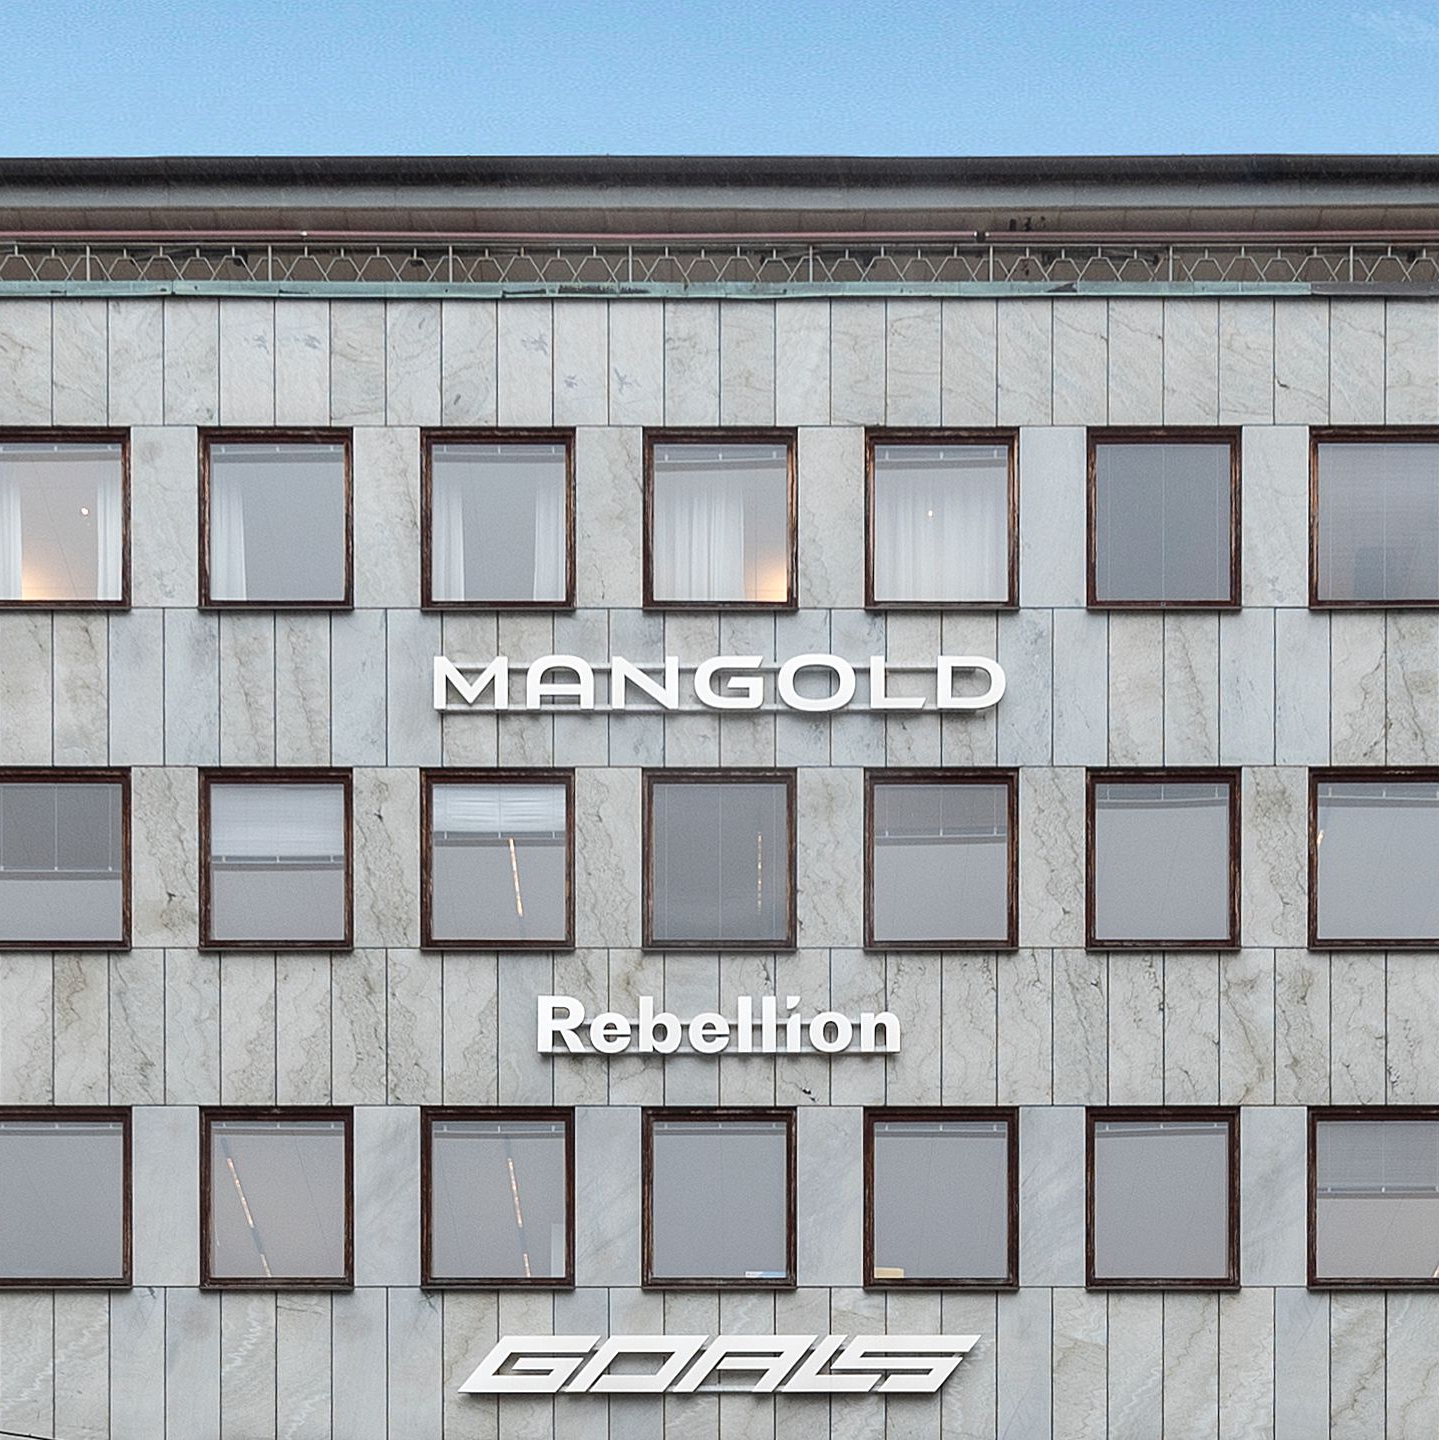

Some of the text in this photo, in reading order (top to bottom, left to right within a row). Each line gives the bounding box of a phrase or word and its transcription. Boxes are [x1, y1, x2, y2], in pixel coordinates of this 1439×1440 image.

[433, 654, 1007, 711] MANGOLD
[537, 996, 901, 1054] Rebellion
[458, 1335, 982, 1393] GOALS
